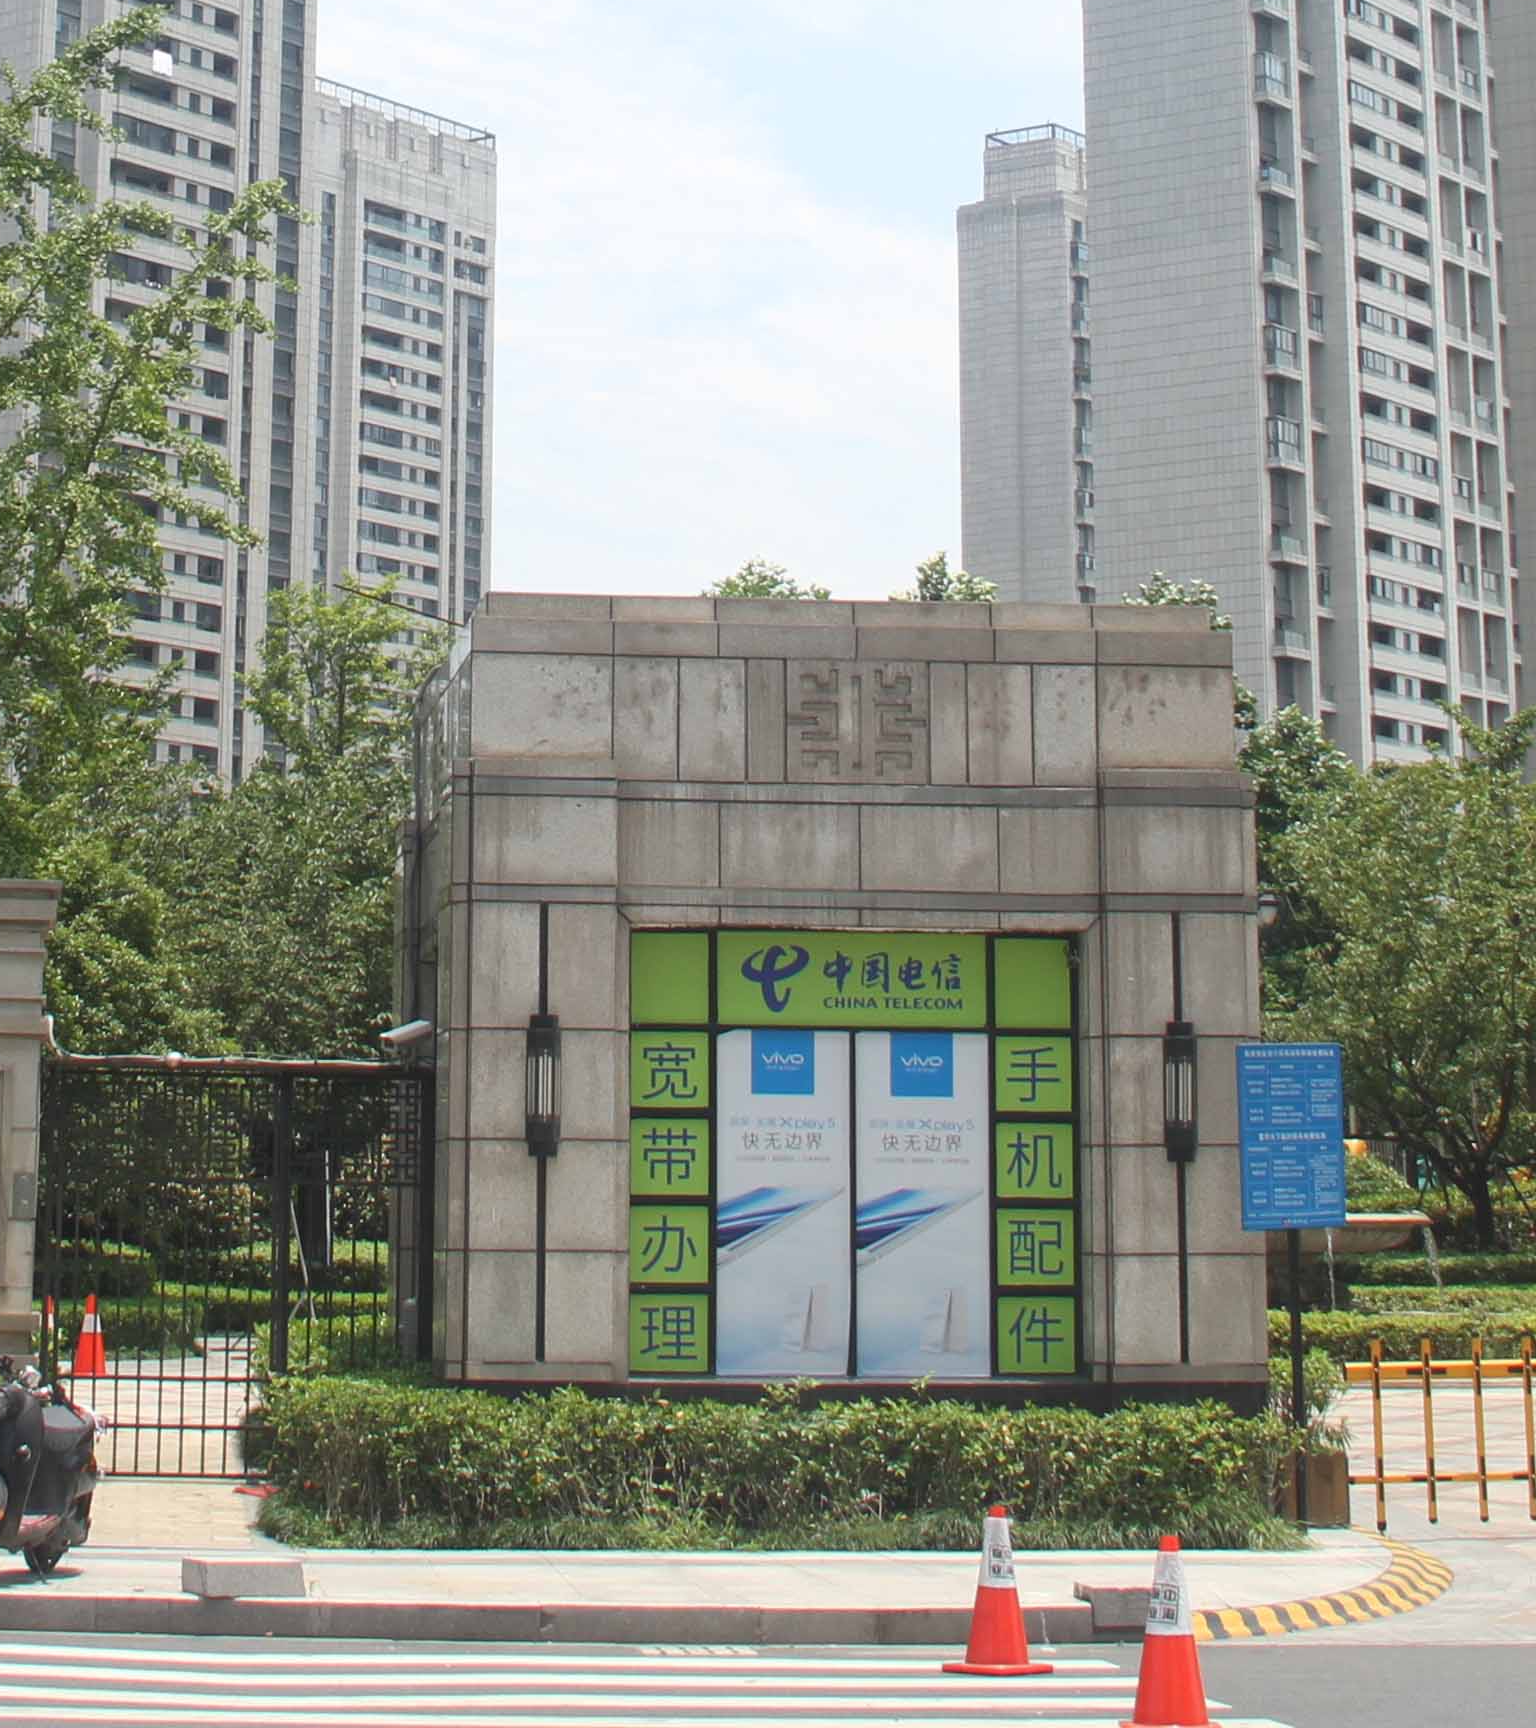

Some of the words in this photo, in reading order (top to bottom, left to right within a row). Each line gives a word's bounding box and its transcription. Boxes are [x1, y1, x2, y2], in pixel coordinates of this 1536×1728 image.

[822, 950, 962, 993] 中国电信
[822, 996, 878, 1010] CHINA
[884, 996, 964, 1010] TELECOM
[761, 1051, 805, 1065] vivo
[900, 1052, 944, 1067] vivo
[742, 1131, 823, 1151] 快无边界
[881, 1133, 961, 1153] 快无边界
[640, 1041, 699, 1362] 宽带办理
[1006, 1046, 1066, 1365] 手机配件
